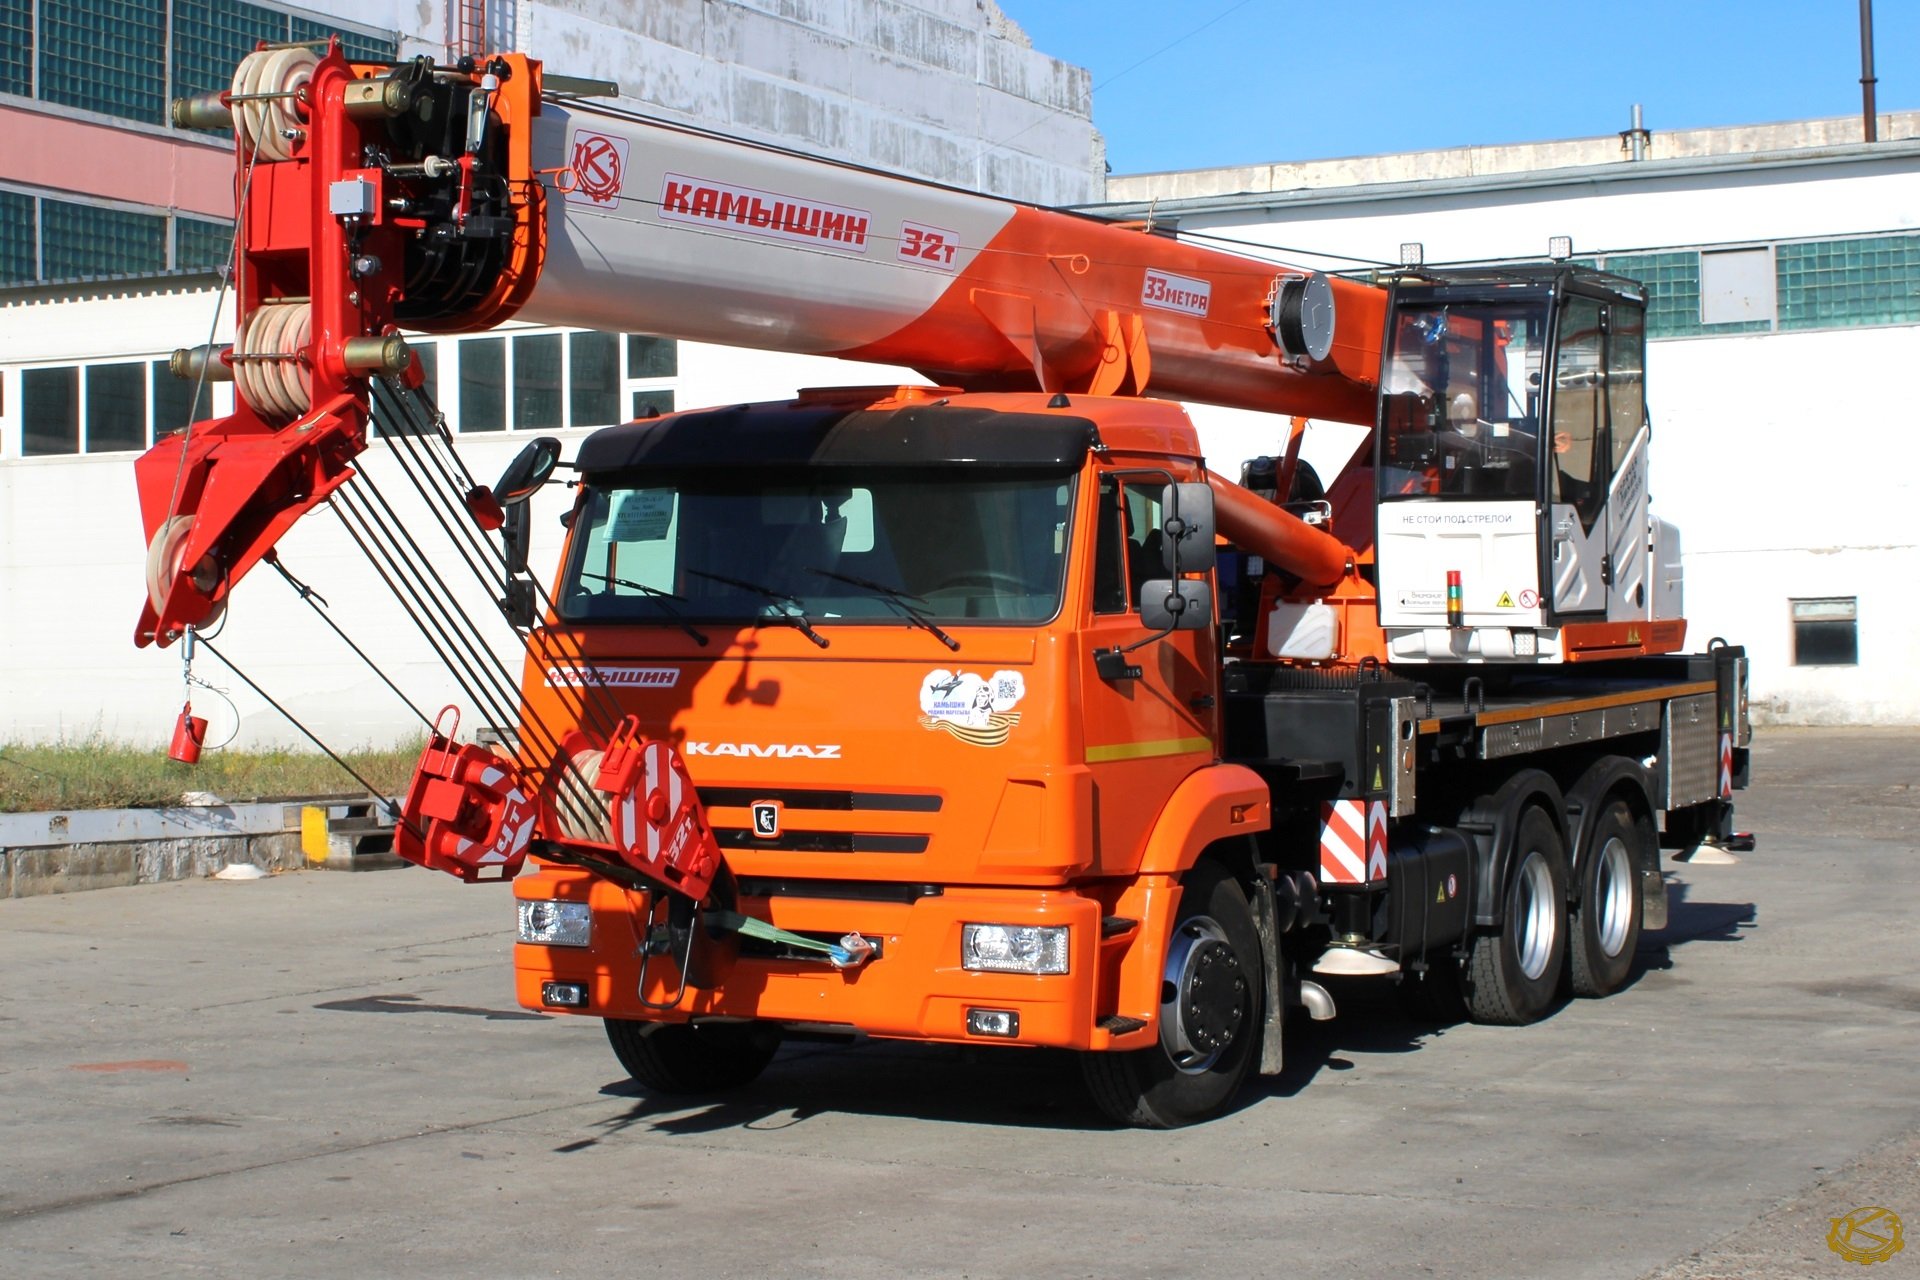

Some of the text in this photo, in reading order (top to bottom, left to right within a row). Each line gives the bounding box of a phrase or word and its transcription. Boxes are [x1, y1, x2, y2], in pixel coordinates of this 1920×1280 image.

[663, 181, 868, 245] КАМЫШИН
[1402, 515, 1415, 524] НЕ
[1444, 514, 1466, 525] ПОД
[686, 741, 842, 759] KAMAZ
